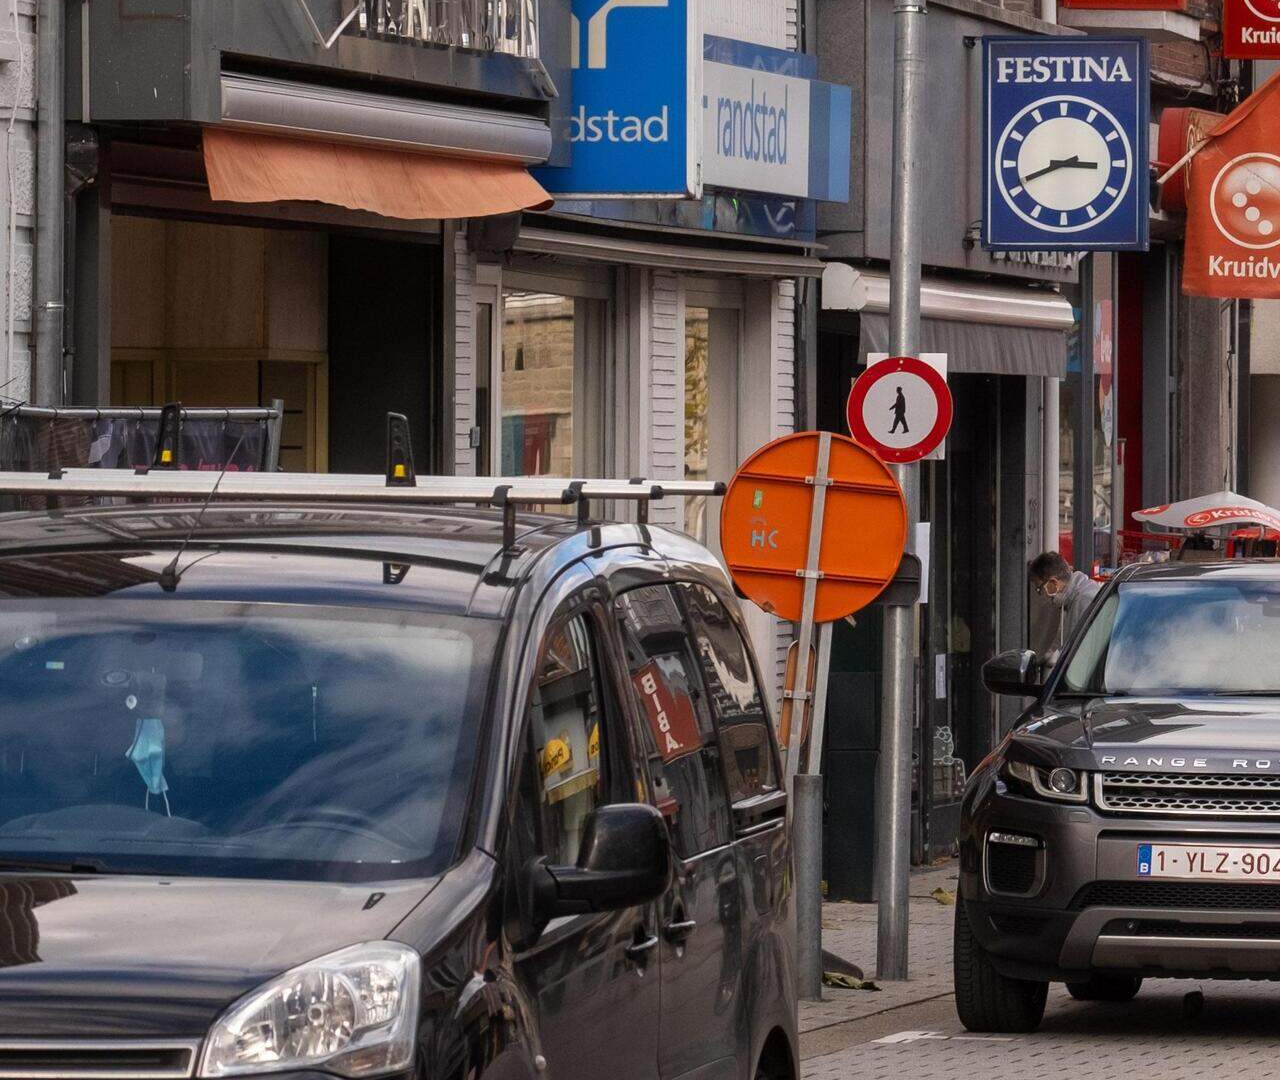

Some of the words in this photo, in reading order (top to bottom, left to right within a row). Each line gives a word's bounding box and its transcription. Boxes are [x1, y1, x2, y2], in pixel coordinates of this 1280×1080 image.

[997, 56, 1132, 83] FESTINA
[570, 105, 668, 142] dstad
[717, 78, 788, 164] randstad
[1102, 755, 1207, 768] RANGE
[1140, 862, 1149, 873] B
